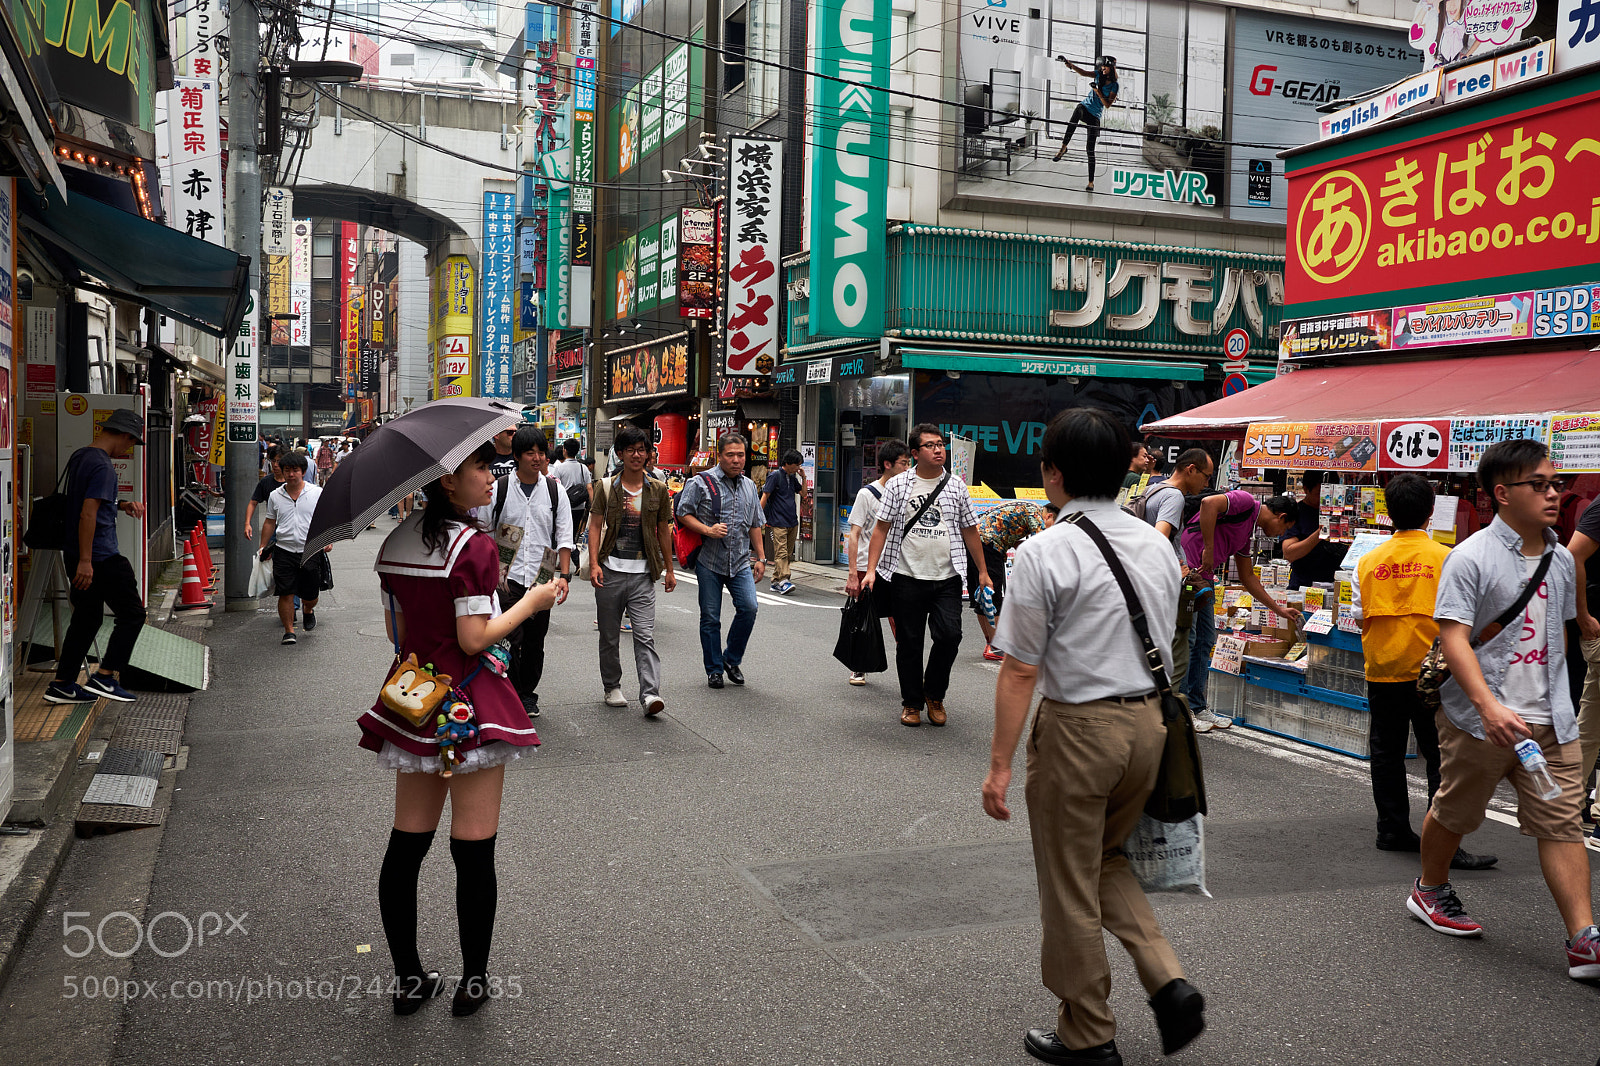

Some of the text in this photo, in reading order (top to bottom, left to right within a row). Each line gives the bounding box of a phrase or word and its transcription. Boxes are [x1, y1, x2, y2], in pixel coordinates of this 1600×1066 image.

[973, 14, 1020, 33] VIVE
[1466, 20, 1500, 34] こちらです
[579, 48, 593, 56] 6F
[580, 59, 591, 68] 4F
[1249, 64, 1341, 103] G-GEAR
[1448, 50, 1544, 96] Free Wifi
[180, 87, 207, 155] 菊正宗
[1321, 83, 1428, 136] English Menu
[1250, 175, 1270, 183] VIVE
[182, 168, 216, 240] 赤津
[271, 201, 283, 239] 千石電商
[1304, 180, 1366, 271] あ
[576, 224, 588, 259] ラーメン
[460, 262, 470, 314] トレーダー2
[689, 272, 706, 280] 2F
[618, 279, 628, 314] 2F
[1536, 289, 1590, 314] HDD
[372, 289, 384, 343] DVD買取
[688, 308, 706, 317] 2F
[1299, 314, 1374, 334] 目指すは宇宙最安値！
[1410, 308, 1513, 334] モバイルバッテリー
[1535, 312, 1589, 336] SSD
[1229, 337, 1244, 352] 20
[235, 320, 252, 401] 福山歯科
[1246, 434, 1301, 457] メモリ
[1300, 445, 1330, 457] 買うなら
[1388, 430, 1441, 459] たばこ
